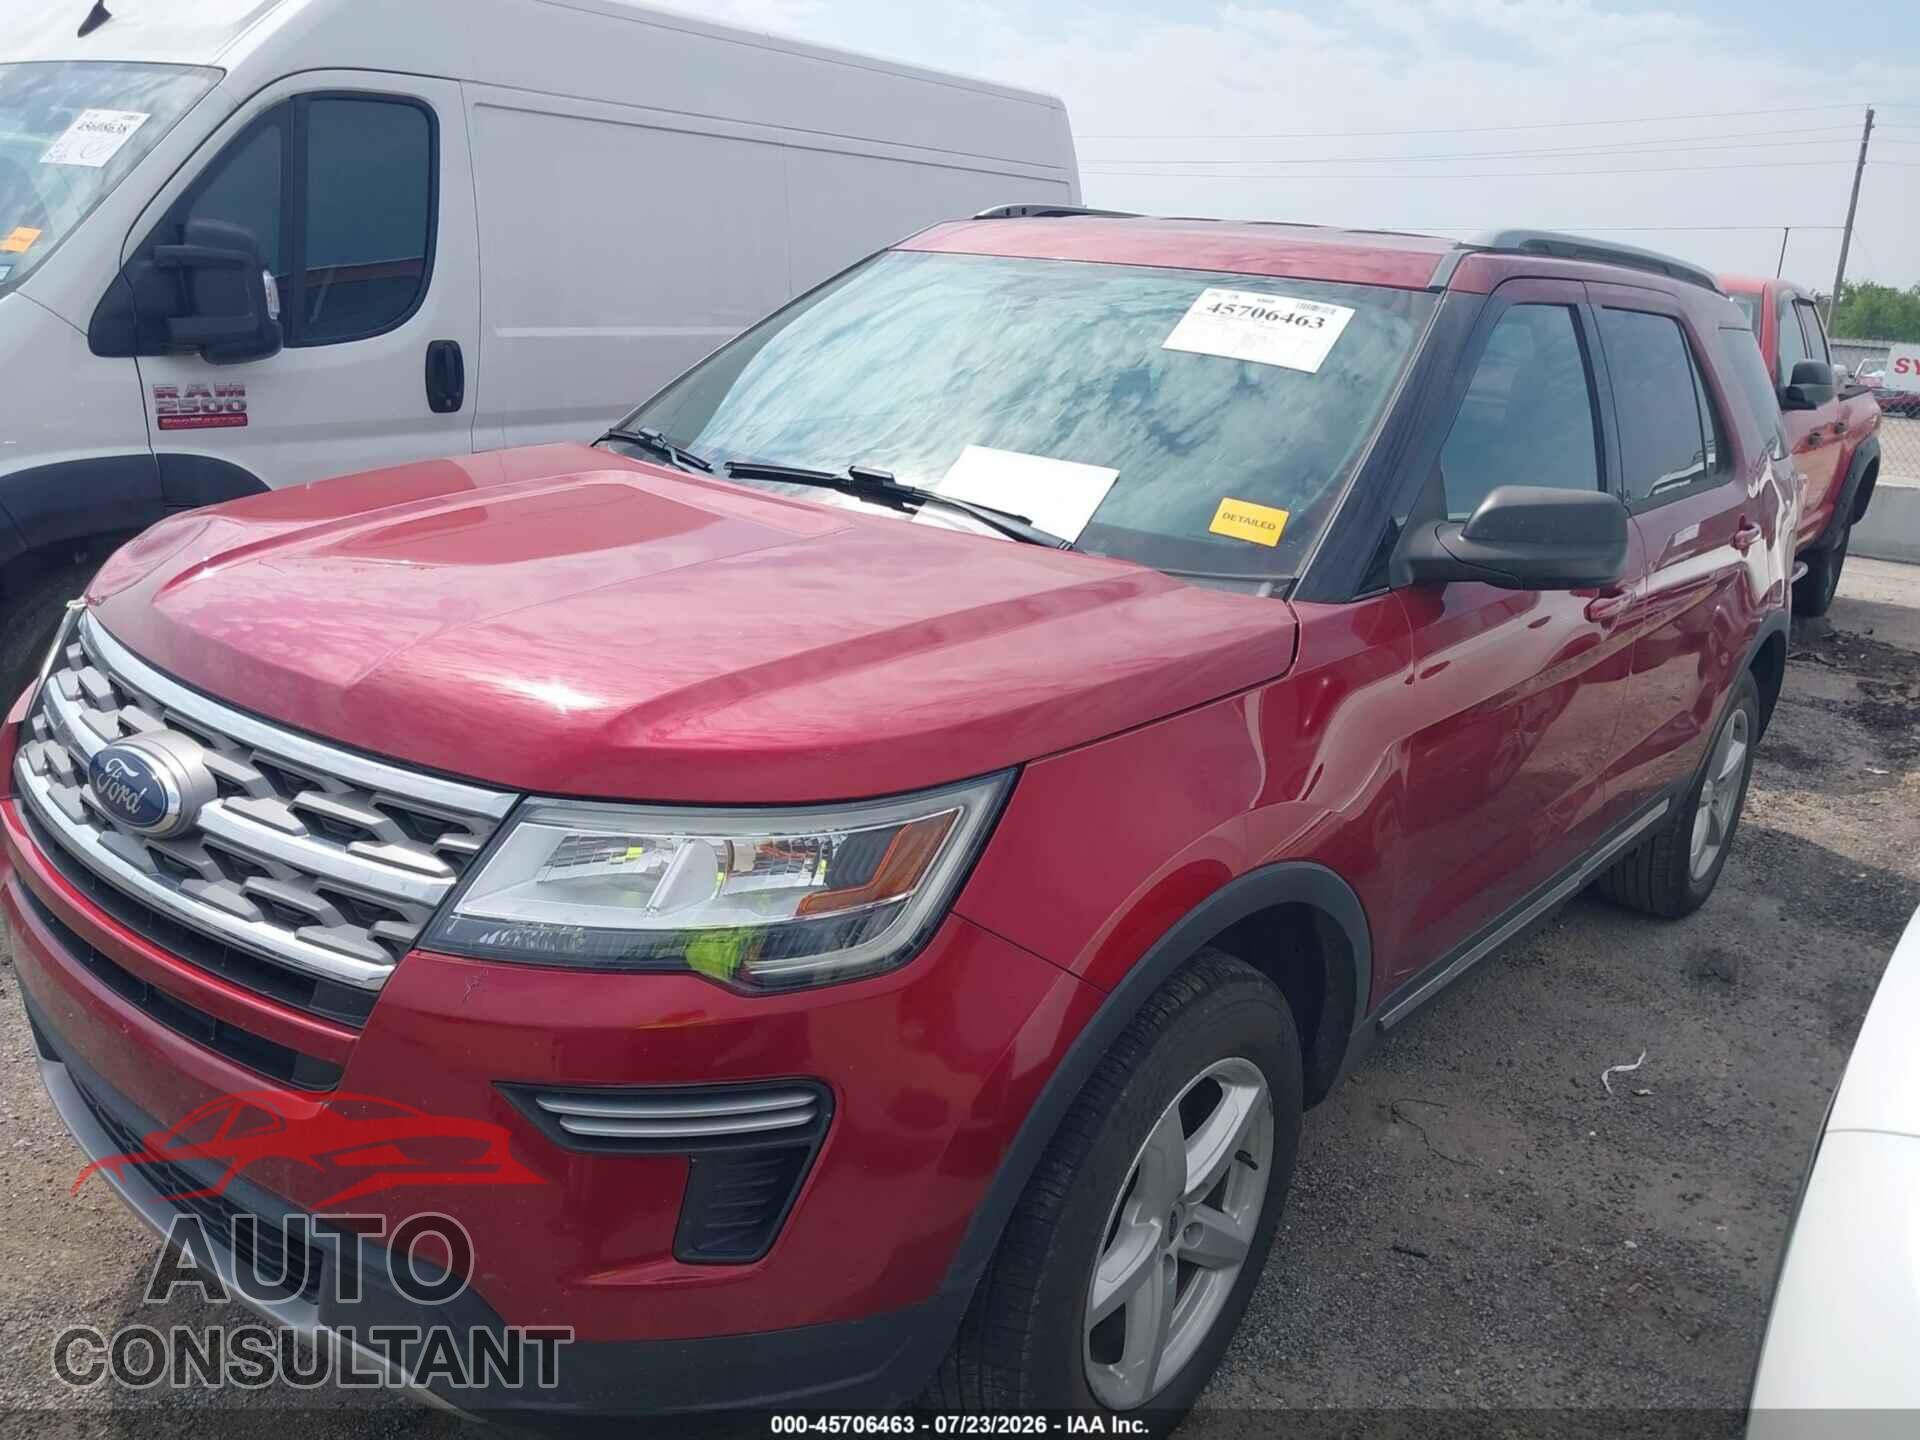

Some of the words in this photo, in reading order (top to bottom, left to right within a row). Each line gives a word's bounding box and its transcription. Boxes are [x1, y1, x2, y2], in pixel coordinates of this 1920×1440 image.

[1207, 302, 1326, 329] 45706463
[153, 383, 246, 399] RAM
[155, 399, 248, 415] 2500
[1222, 511, 1277, 530] DETAILED
[96, 757, 148, 815] Ford
